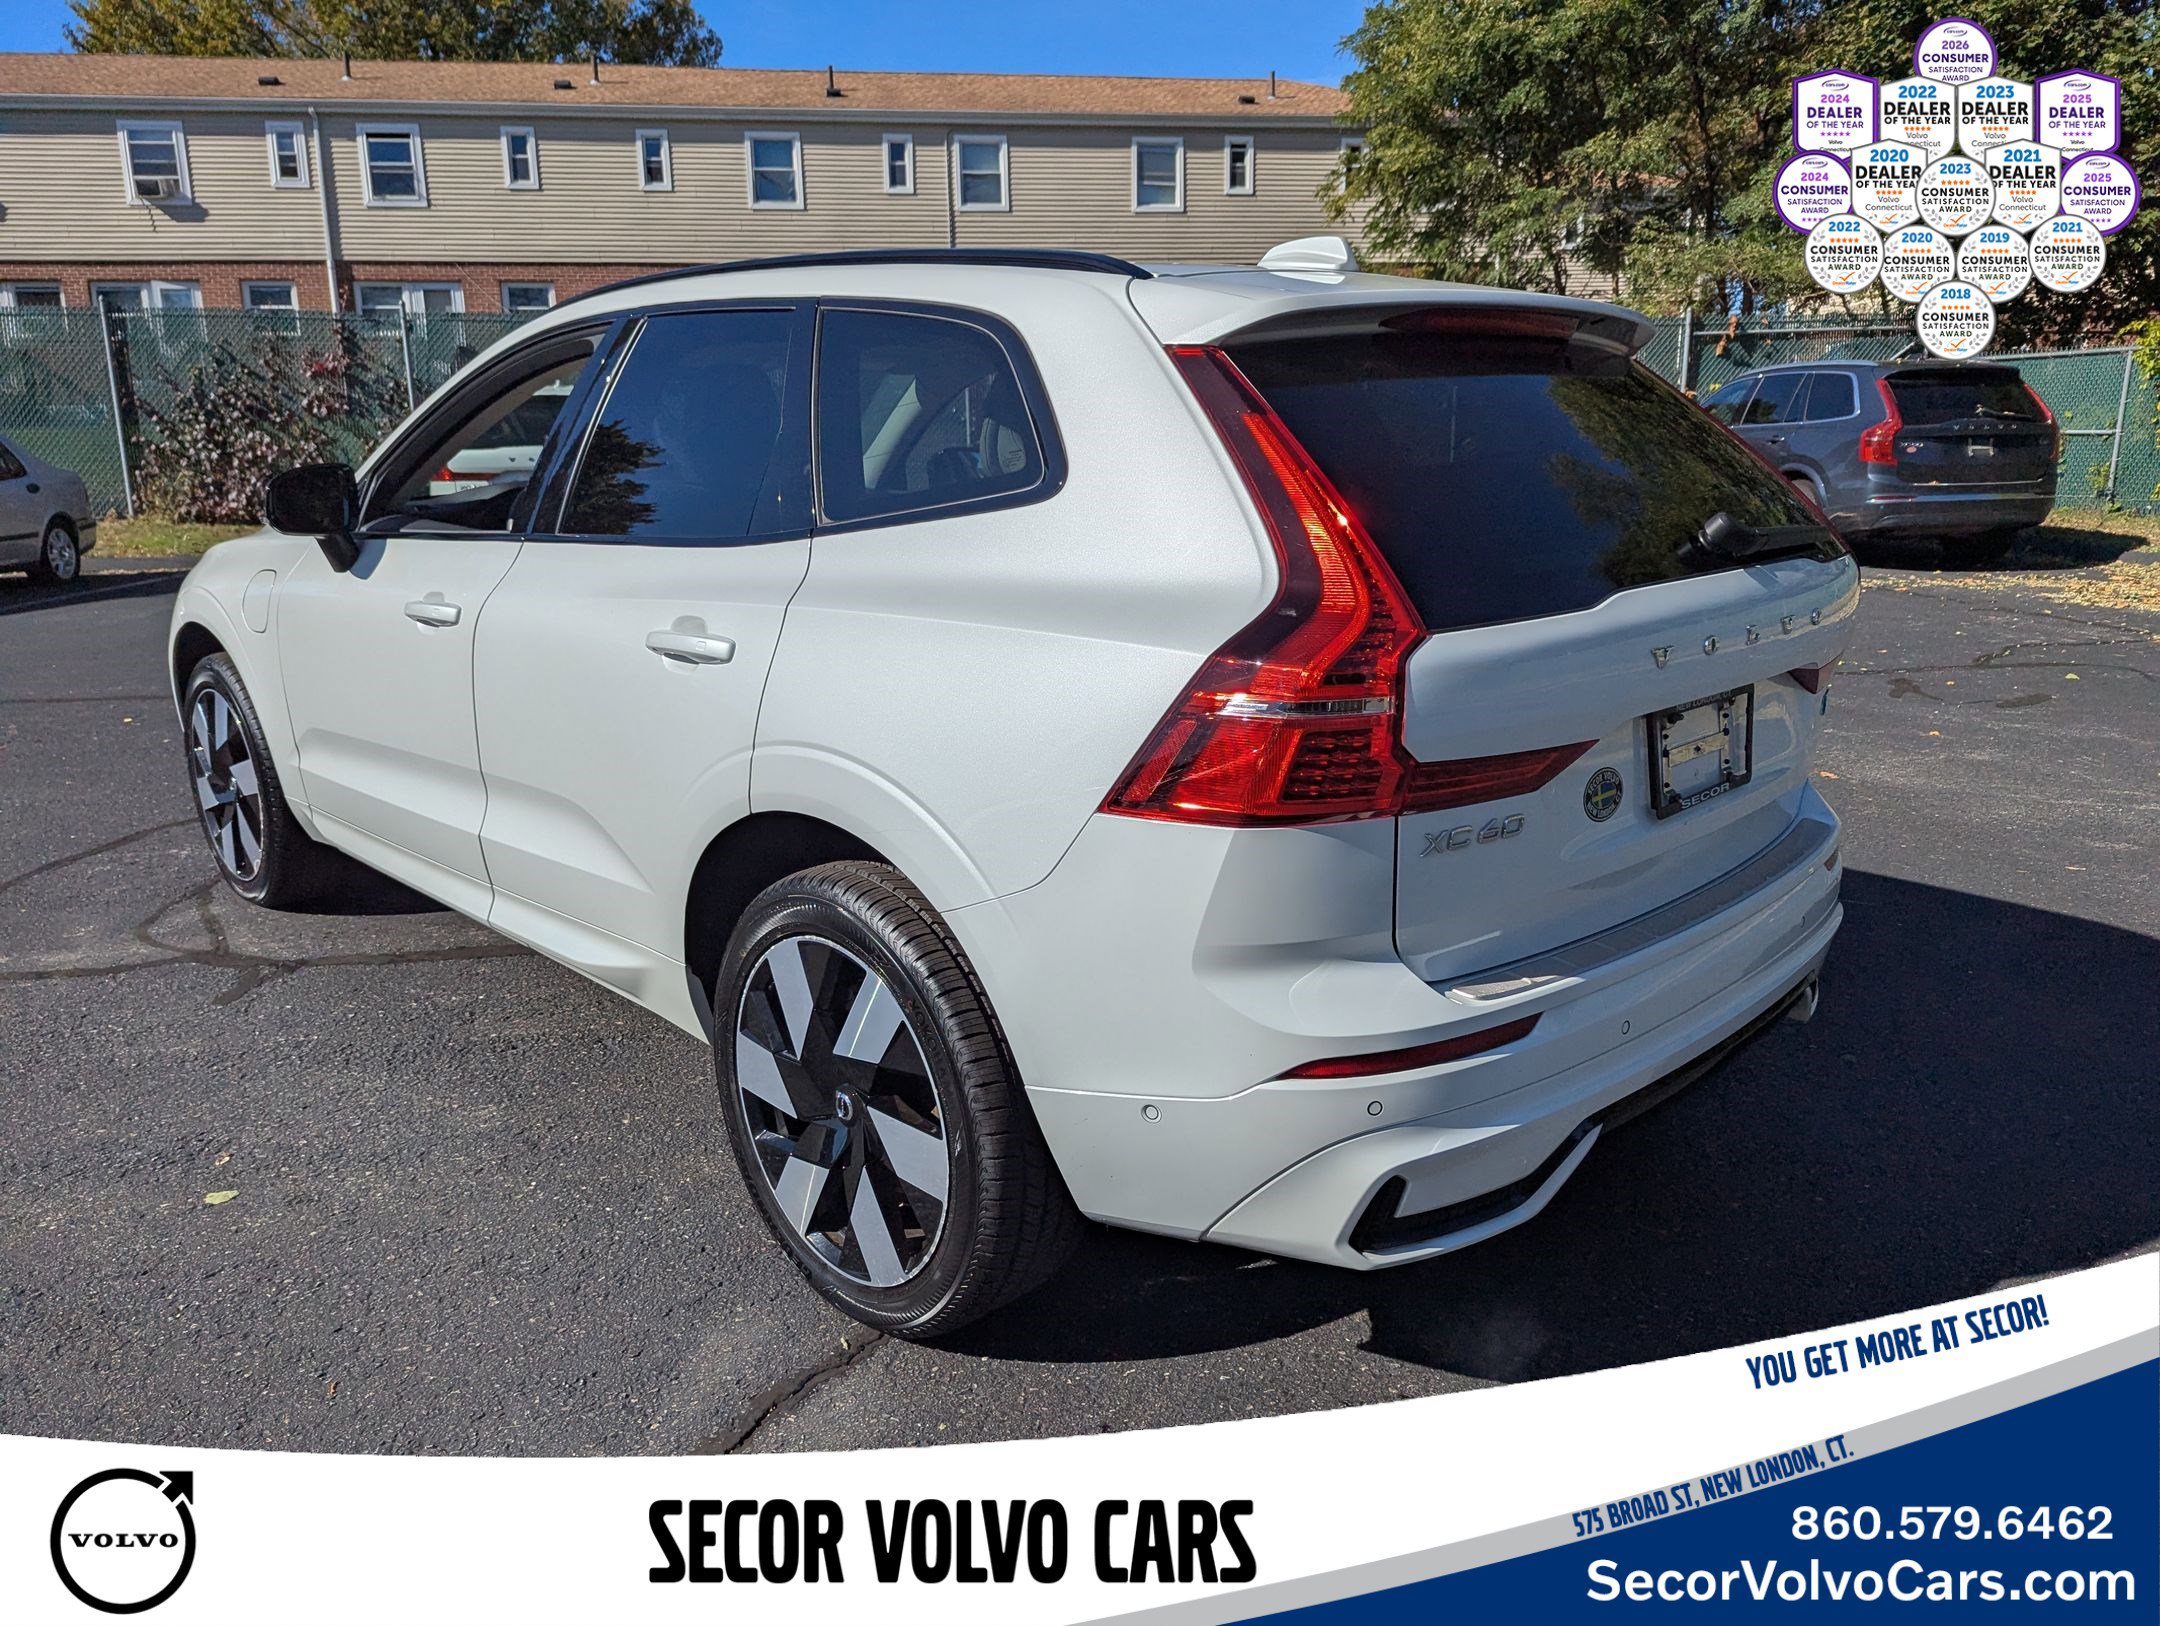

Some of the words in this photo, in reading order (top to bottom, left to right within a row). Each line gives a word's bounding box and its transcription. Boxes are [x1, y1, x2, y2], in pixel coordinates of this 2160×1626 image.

[1651, 607, 1823, 670] VOLVO
[1681, 782, 1730, 809] SECOR
[1419, 812, 1525, 858] XC60
